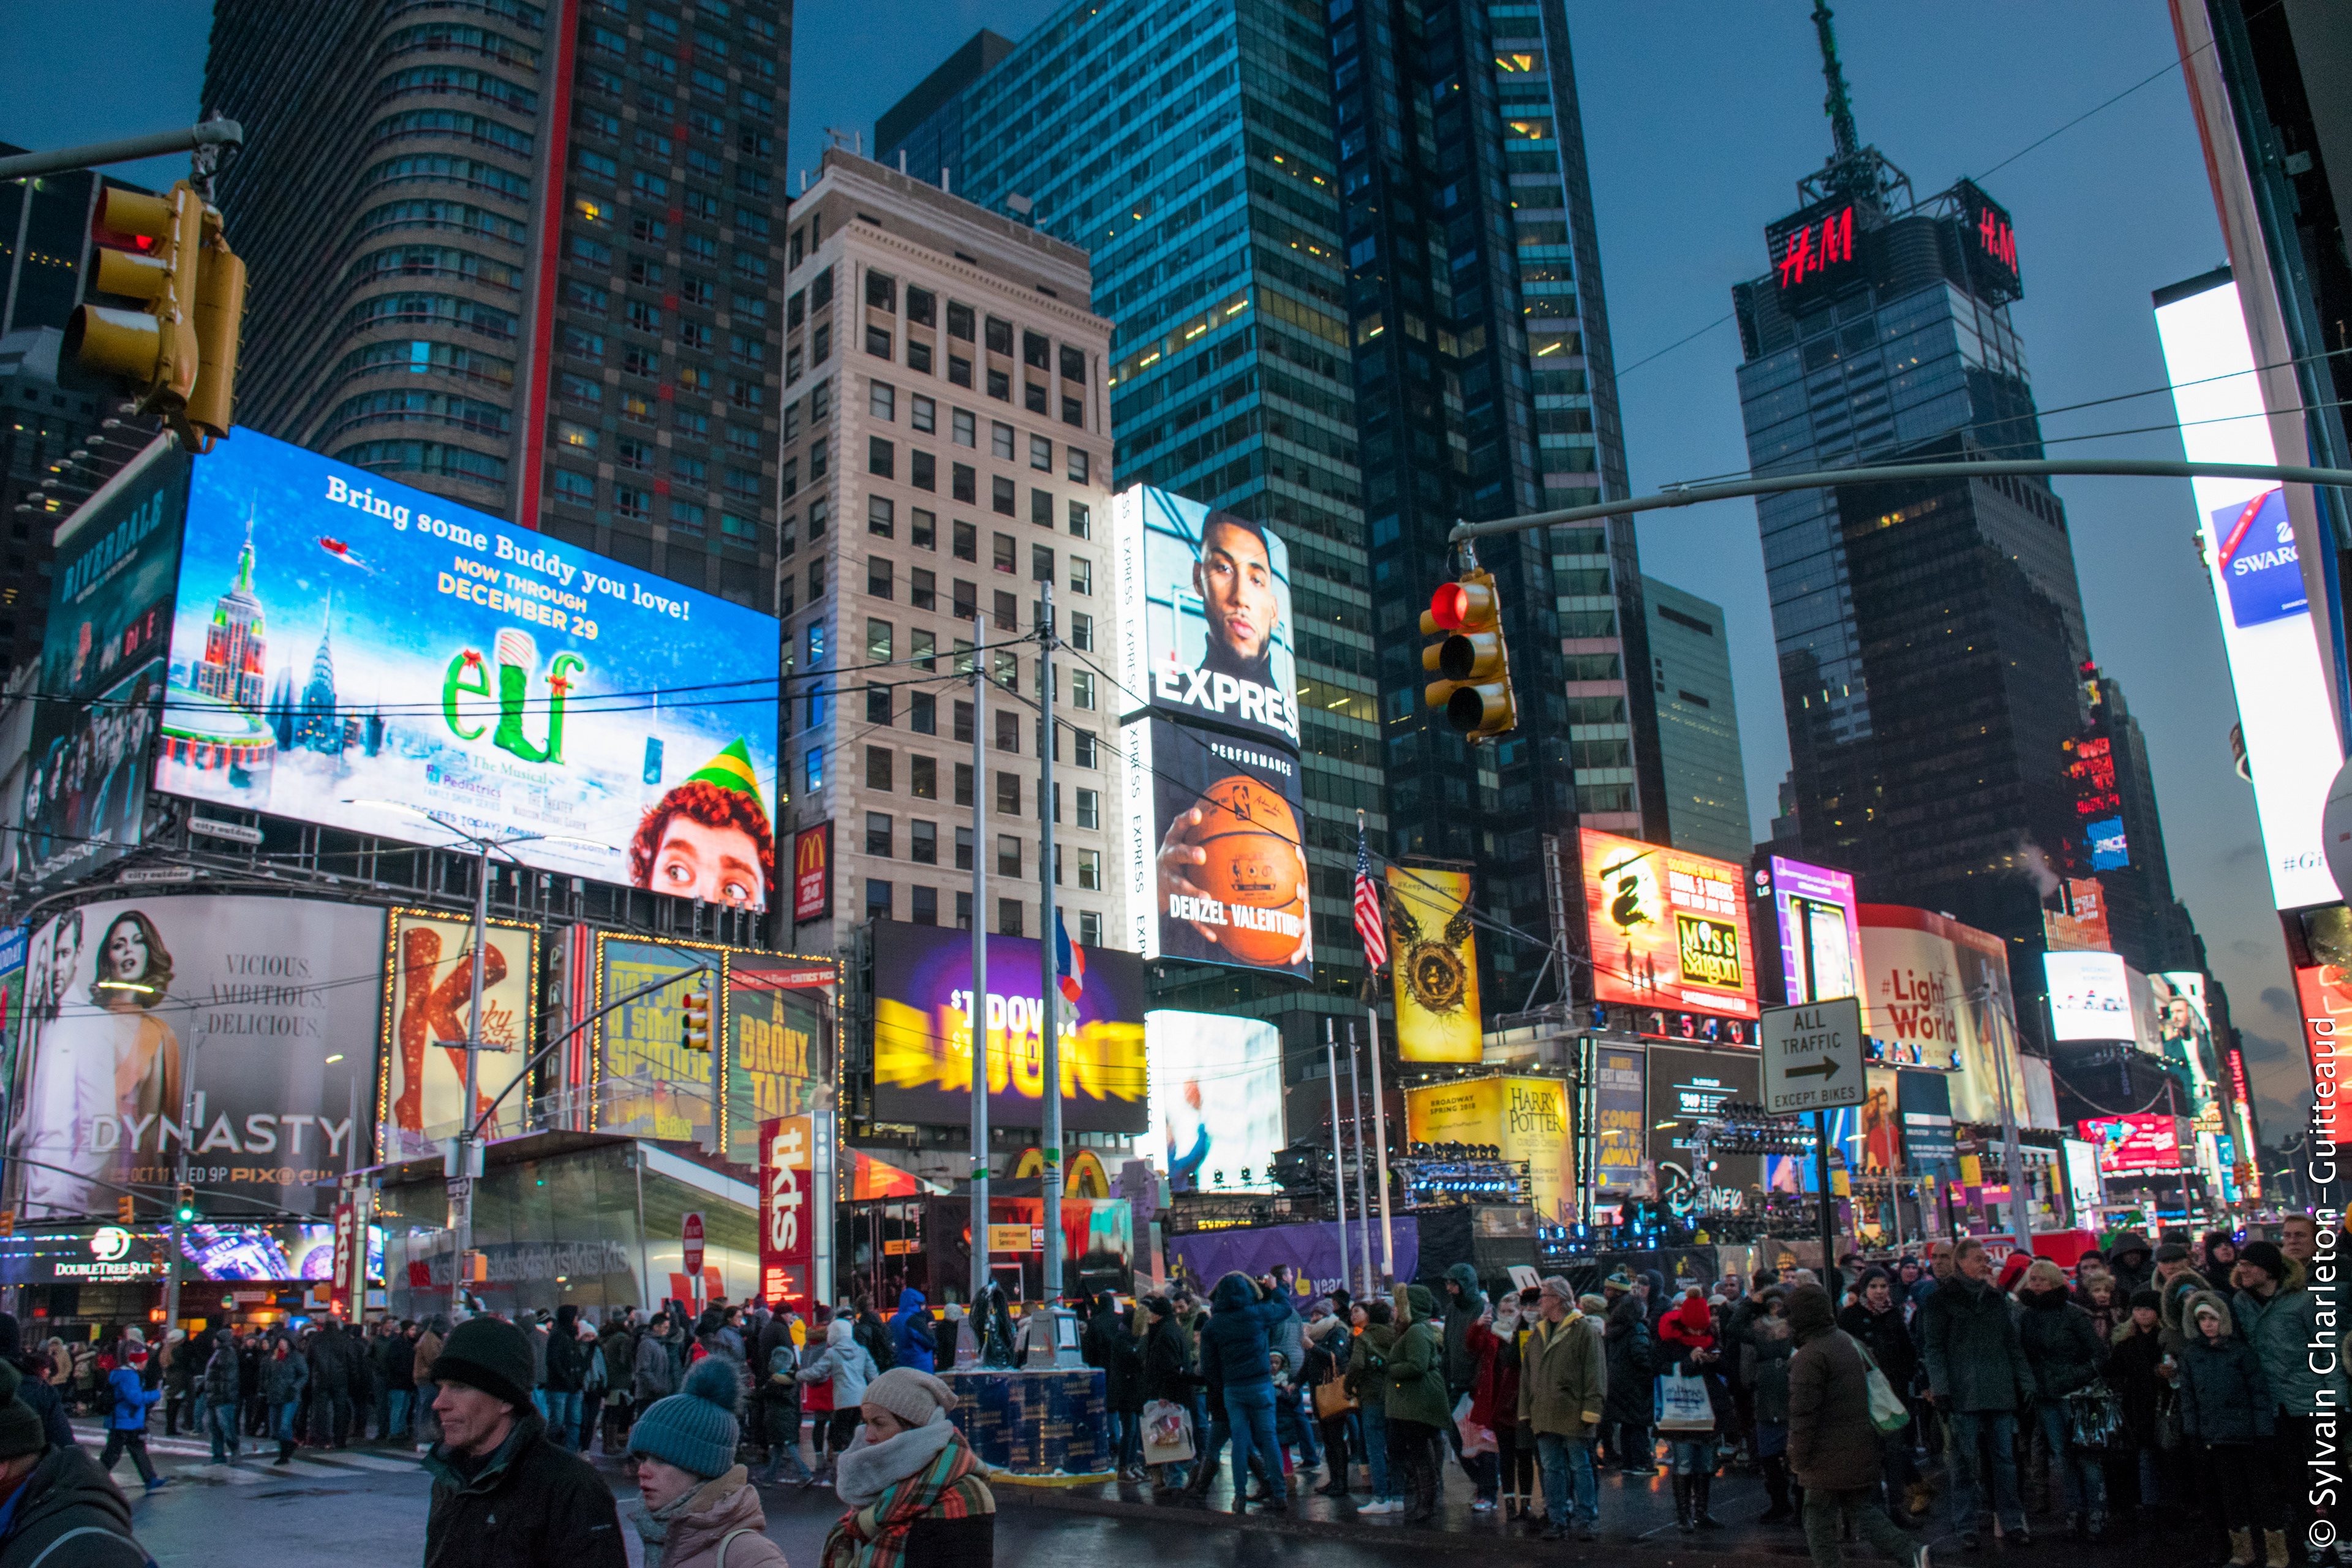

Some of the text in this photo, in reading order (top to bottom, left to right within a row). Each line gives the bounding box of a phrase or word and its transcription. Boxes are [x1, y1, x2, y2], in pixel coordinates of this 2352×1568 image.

[1779, 206, 1852, 288] H&M
[62, 489, 163, 603] RIVERDALE
[325, 475, 690, 621] Bring some Buddy you love!
[454, 556, 587, 613] NOW THROUGH
[1123, 537, 1133, 605] EXPRESS
[437, 571, 598, 641] DECEMBER 29
[1126, 619, 1136, 695] EXPRESS
[442, 627, 586, 766] elf
[1155, 657, 1301, 747] EXPRES
[472, 755, 547, 785] The Musical
[1210, 742, 1292, 777] PERFORMANCE
[443, 774, 502, 799] Pediatrics
[1133, 815, 1144, 894] EXPRESS
[1757, 886, 1771, 897] LG
[1170, 894, 1300, 938] DENZEL VALENTINE
[227, 954, 312, 979] VICIOUS.
[1683, 947, 1740, 985] Saigon
[609, 971, 654, 1006] NOT
[772, 988, 785, 1025] A
[208, 1012, 321, 1039] DELICIOUS.
[608, 1005, 624, 1038] A
[951, 989, 974, 1028] $1
[1793, 1010, 1826, 1031] ALL
[1887, 1003, 1958, 1043] World
[608, 1039, 713, 1083] SPONGE
[740, 1014, 809, 1078] BRONX
[1782, 1033, 1841, 1054] TRAFFIC
[1430, 1095, 1474, 1107] BROADWAY
[1430, 1103, 1457, 1115] SPRING
[1510, 1087, 1558, 1113] HARRY
[1775, 1087, 1855, 1107] EXCEPT BIKES
[90, 1110, 353, 1157] DYNASTY
[1509, 1110, 1566, 1133] POTTER
[1600, 1110, 1642, 1128] COME
[130, 1167, 154, 1183] OCT
[209, 1166, 228, 1183] 9P
[1599, 1148, 1640, 1166] AWAY
[772, 1127, 804, 1252] tkts
[336, 1209, 352, 1289] tkts
